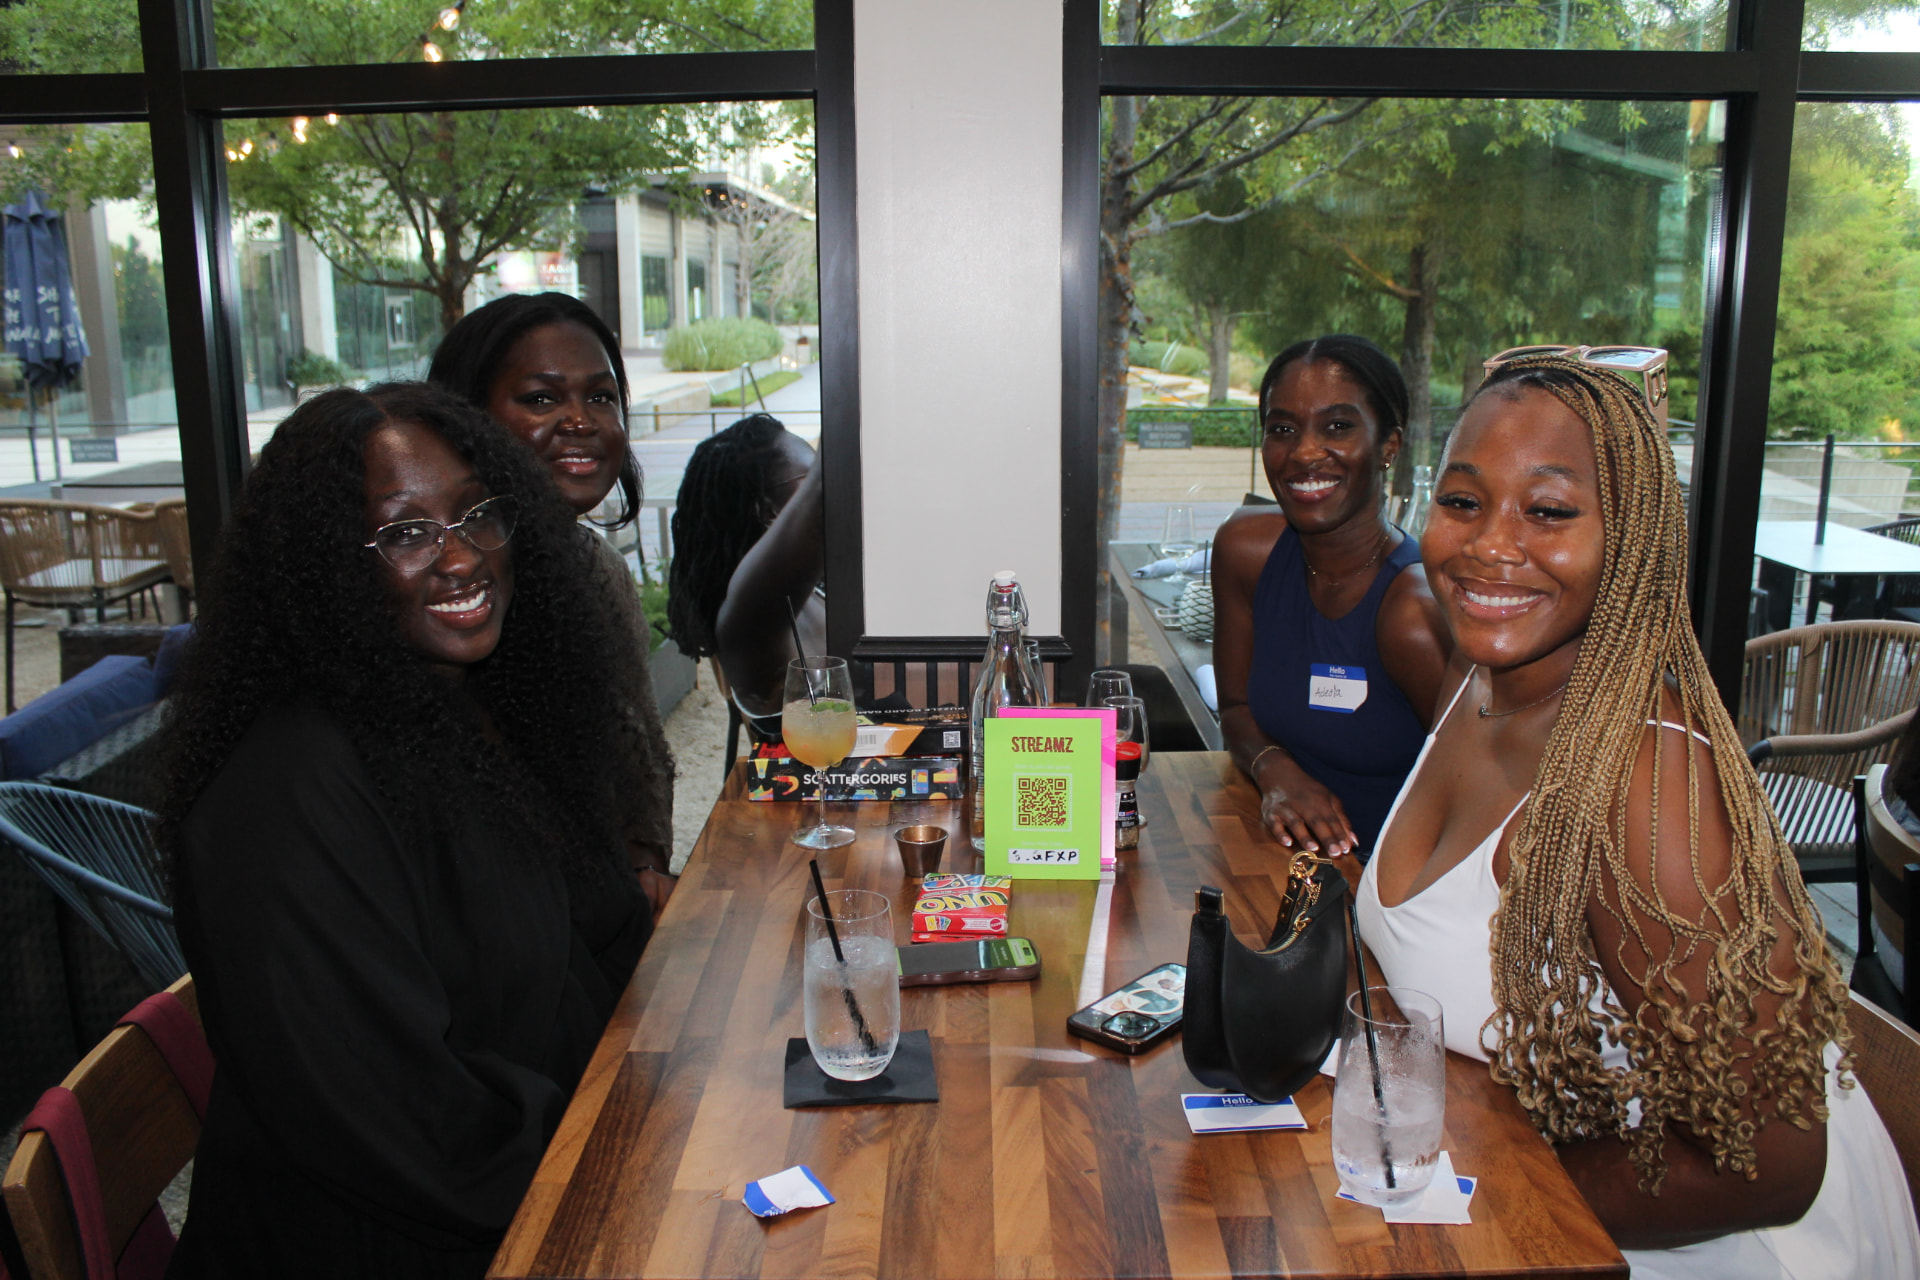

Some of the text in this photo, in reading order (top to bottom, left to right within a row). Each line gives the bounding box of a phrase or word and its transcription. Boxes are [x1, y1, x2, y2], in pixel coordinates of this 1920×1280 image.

[1329, 666, 1346, 675] Hello
[1011, 736, 1074, 753] STREAMZ
[803, 773, 907, 785] SCATTERGORIES
[914, 890, 1008, 913] UNO
[1221, 1097, 1254, 1105] Hello
